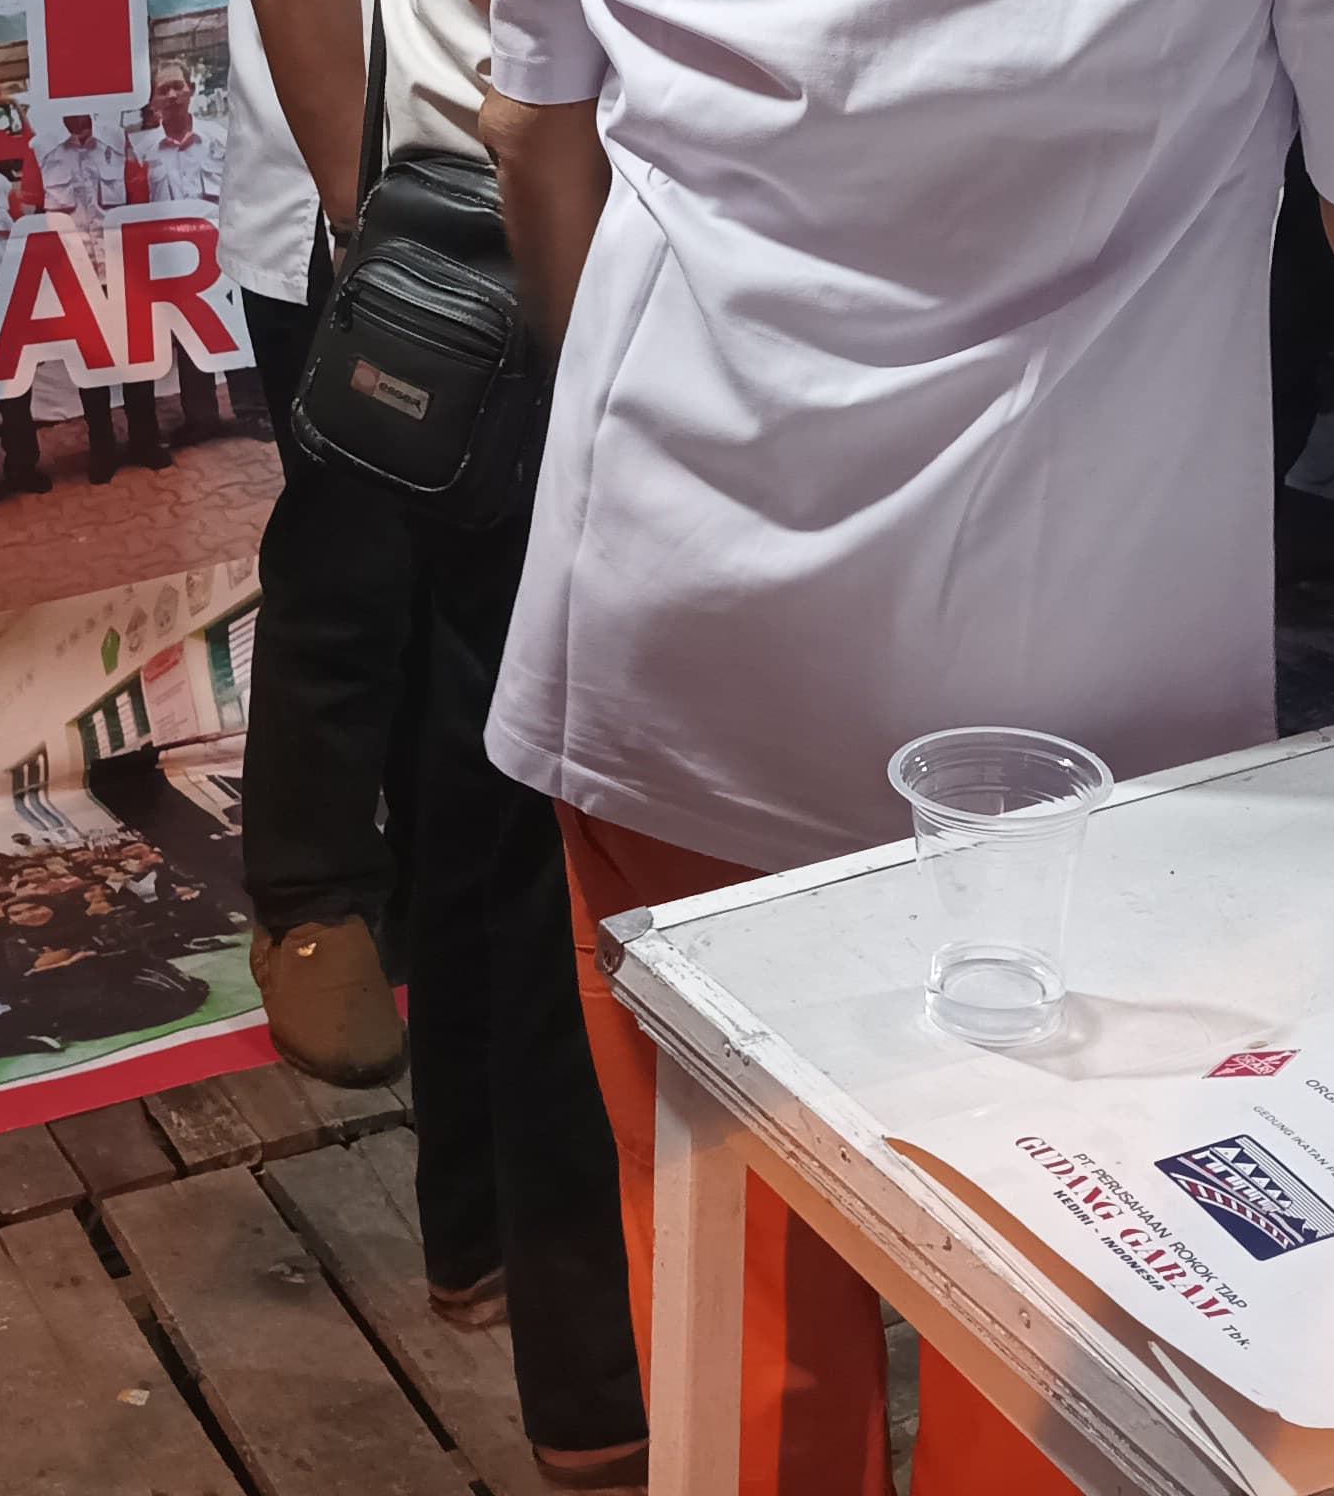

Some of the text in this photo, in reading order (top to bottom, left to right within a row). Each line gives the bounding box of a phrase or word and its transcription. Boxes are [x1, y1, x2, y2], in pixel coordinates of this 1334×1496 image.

[1253, 1105, 1294, 1138] GEDUNG
[1291, 1136, 1329, 1167] IKATAN
[1016, 1137, 1249, 1350] GUDANG GARAM Tbk.
[1053, 1190, 1094, 1225] KEDIRI
[1101, 1236, 1166, 1291] INDONESIA
[1091, 1168, 1172, 1239] PERUSAHAAN
[1169, 1242, 1218, 1283] ROKOK
